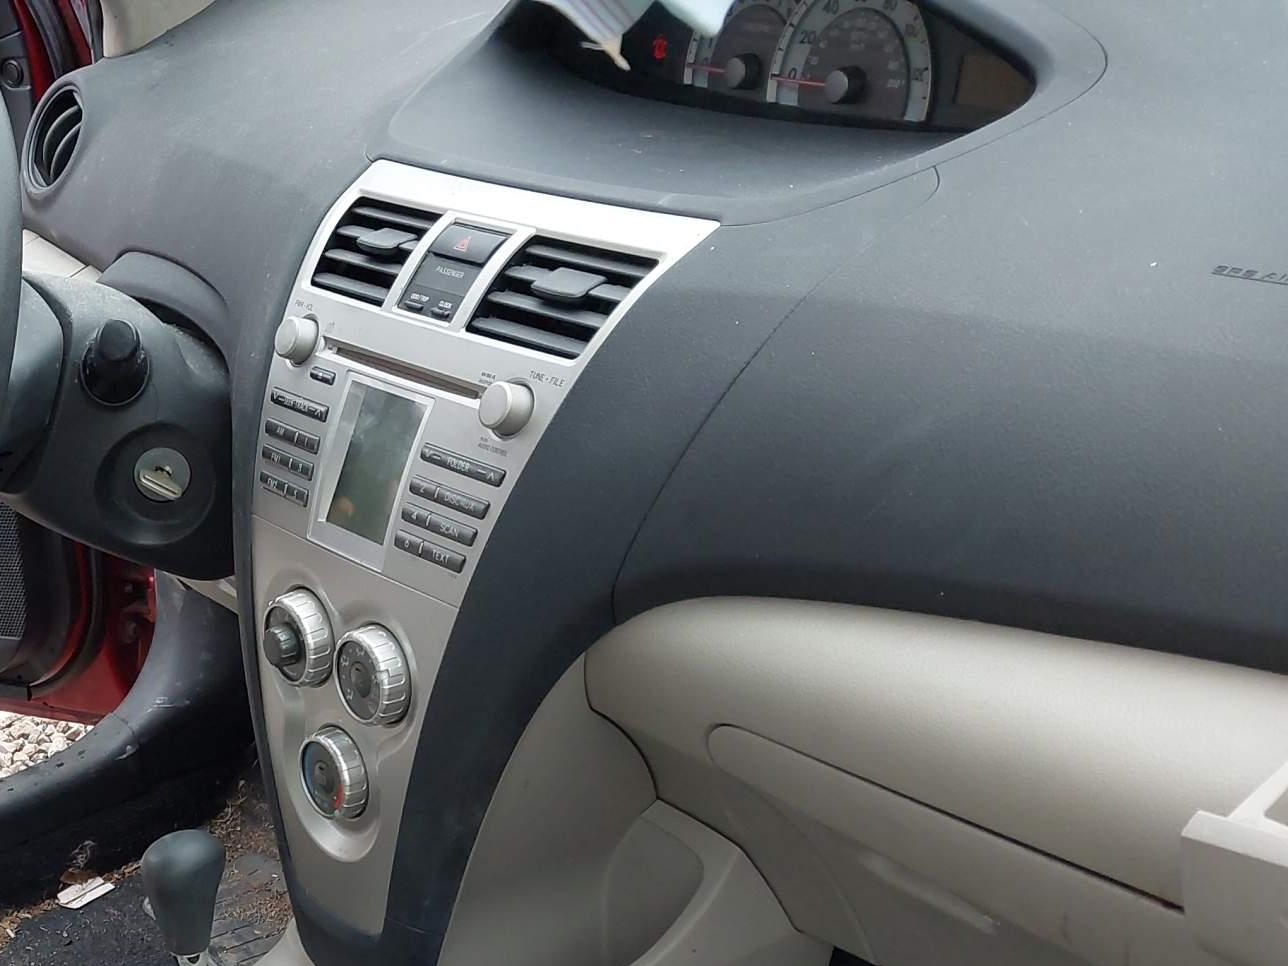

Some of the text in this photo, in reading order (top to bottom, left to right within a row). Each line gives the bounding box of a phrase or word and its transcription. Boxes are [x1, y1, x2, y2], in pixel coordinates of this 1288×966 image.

[799, 31, 817, 45] 20
[549, 376, 566, 388] FILE
[447, 457, 471, 473] FOLDER
[440, 520, 459, 538] SCAN
[432, 549, 449, 564] TEXT
